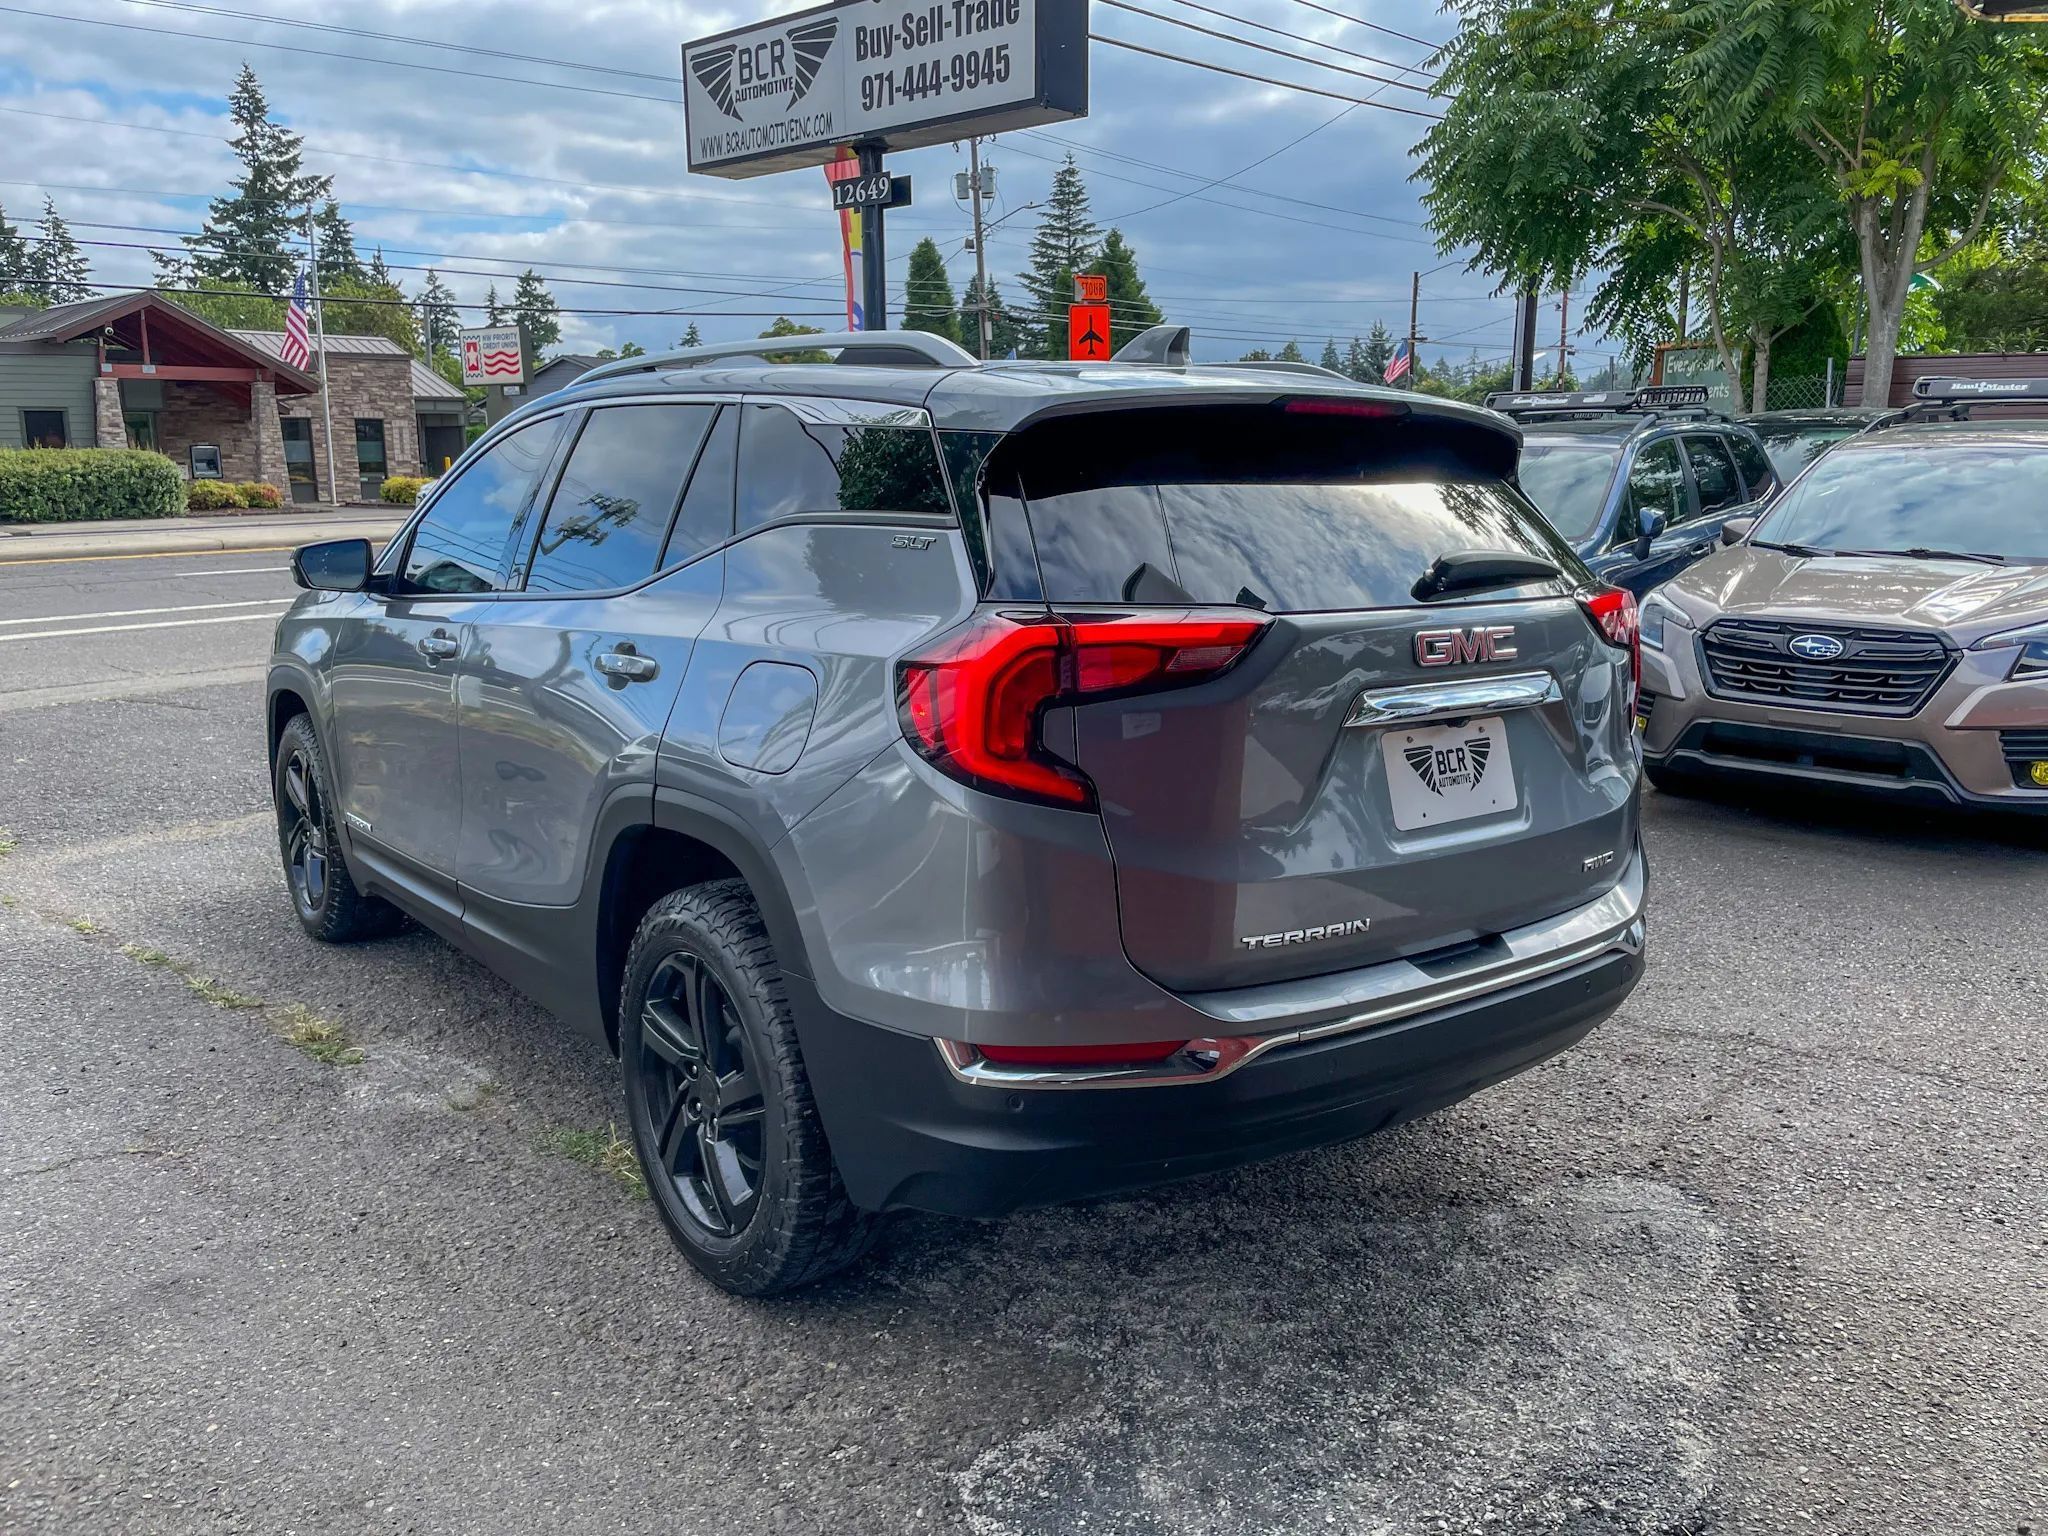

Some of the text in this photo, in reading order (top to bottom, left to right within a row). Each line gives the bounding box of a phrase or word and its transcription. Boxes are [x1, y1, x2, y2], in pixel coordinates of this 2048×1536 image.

[855, 0, 1020, 62] Buy-Sell-Trade
[738, 39, 786, 86] BCR
[735, 76, 794, 103] AUTOMOTIVE
[861, 43, 1011, 112] 971-444-9945
[700, 111, 834, 159] WWW.BCRAUTOMOTIVEINC.COM
[835, 176, 889, 206] 12649
[1082, 282, 1104, 296] TOUR
[493, 332, 517, 340] PRIORITY
[501, 341, 518, 349] UNION
[891, 534, 937, 551] SLT
[1414, 626, 1518, 667] GMC
[1435, 747, 1468, 775] BCR
[1439, 773, 1472, 788] AUTOMOTIVE
[1241, 918, 1371, 950] TERRAIN
